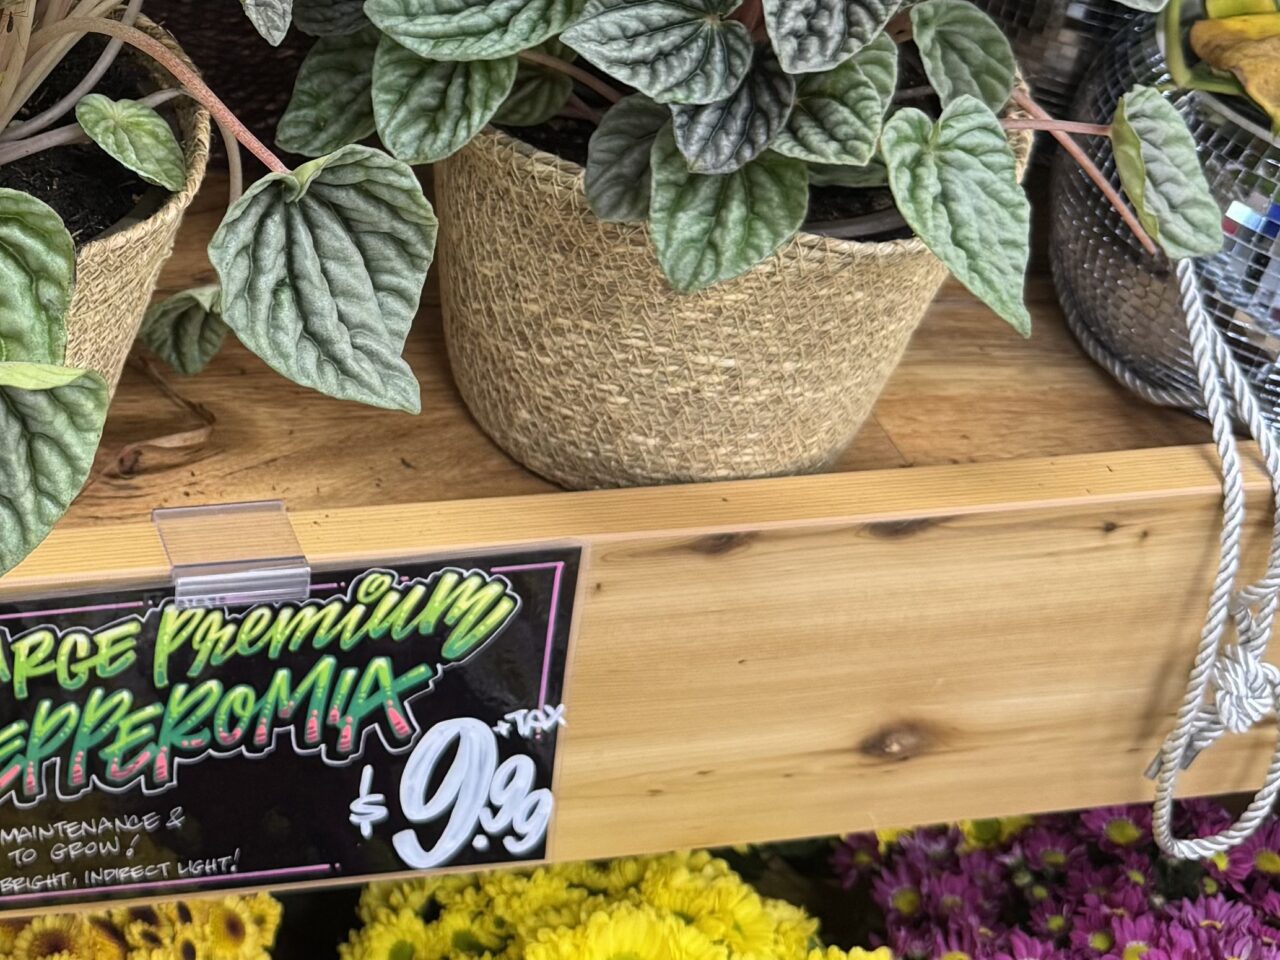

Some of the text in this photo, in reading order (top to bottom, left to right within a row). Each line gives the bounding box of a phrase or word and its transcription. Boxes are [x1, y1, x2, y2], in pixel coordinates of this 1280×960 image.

[166, 806, 186, 830] &
[7, 848, 38, 867] TO
[85, 862, 171, 886] INDIRECT
[177, 848, 241, 878] LIGHT!
